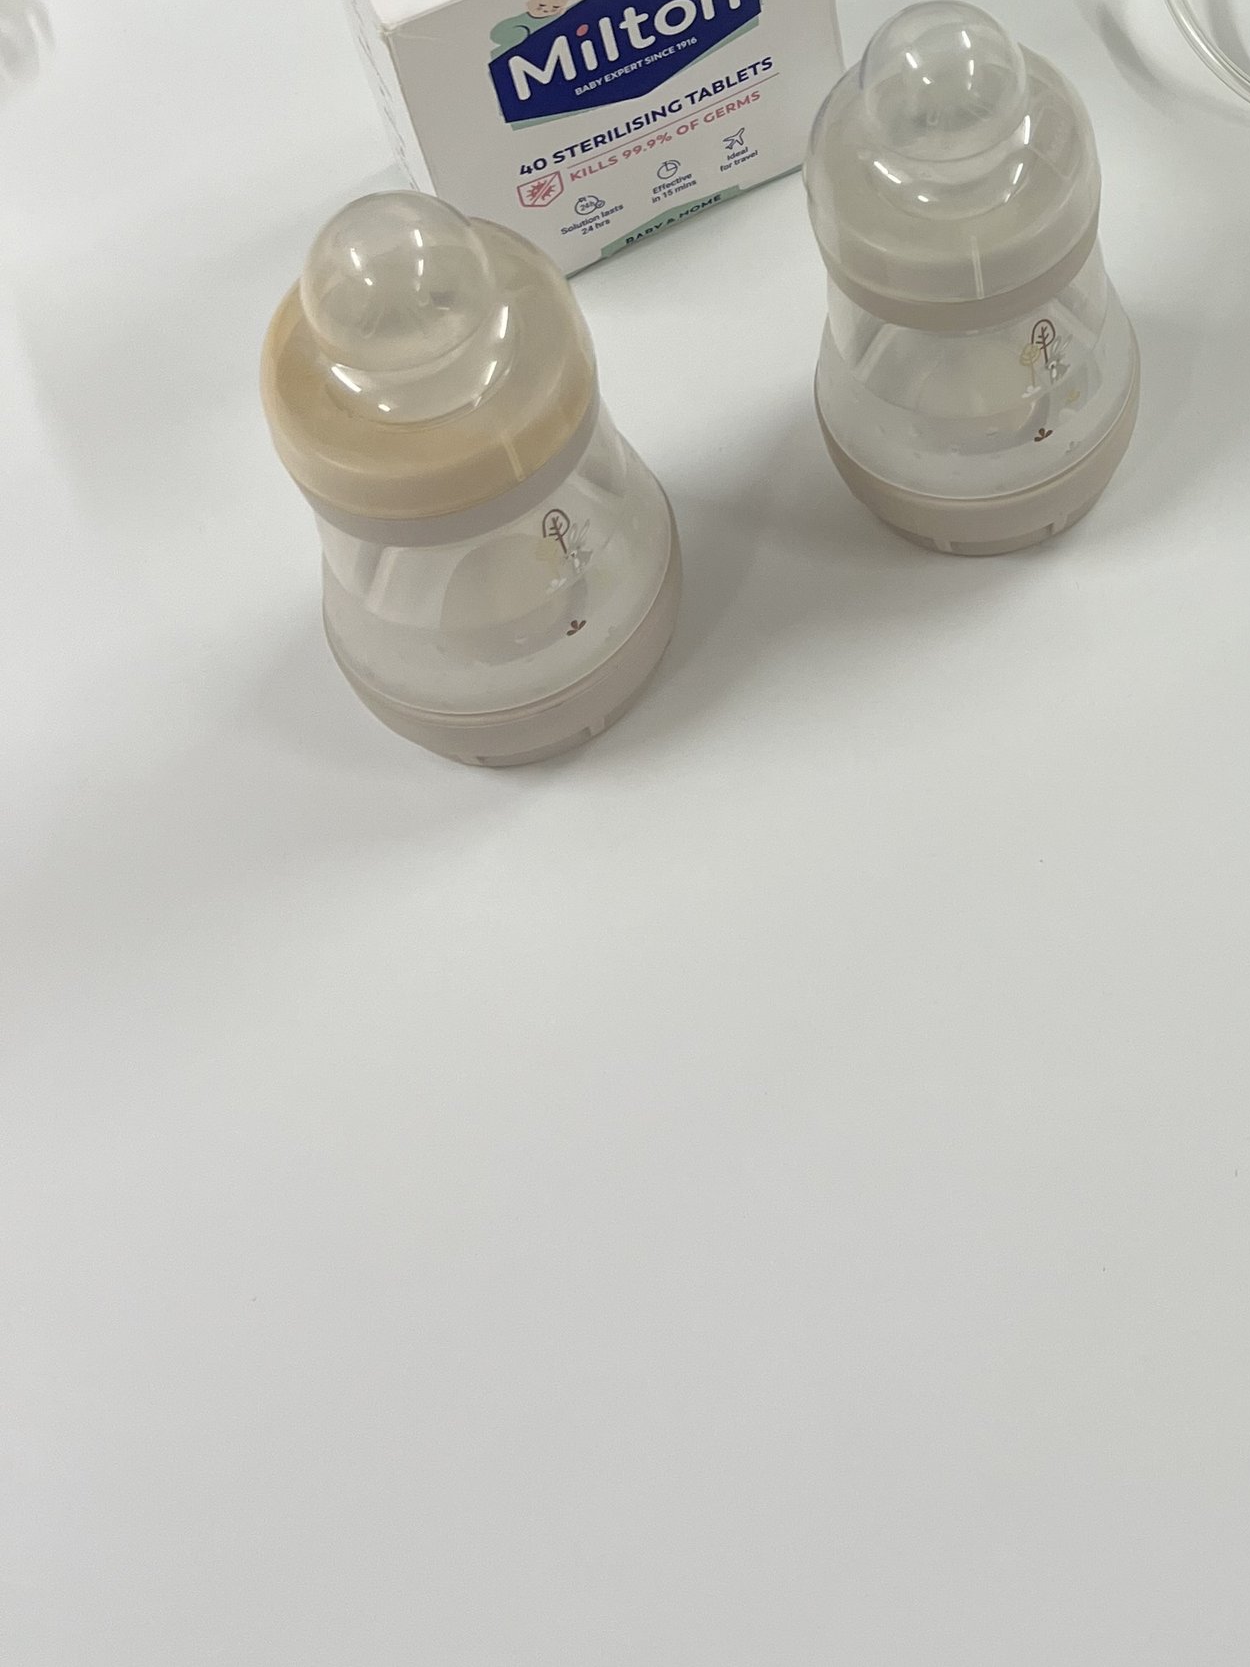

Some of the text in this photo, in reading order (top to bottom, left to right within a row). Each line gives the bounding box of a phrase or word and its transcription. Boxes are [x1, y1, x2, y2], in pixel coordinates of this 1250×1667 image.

[575, 36, 698, 96] BABY EXPERT SINCE 1916
[519, 56, 774, 177] 40 STERILISING TABLETS
[569, 90, 761, 182] KILLS 99.9% OF GERMS
[719, 149, 759, 172] for travel
[726, 146, 749, 162] Ideal
[652, 173, 693, 195] Effective
[652, 178, 698, 204] in 15 mins
[560, 203, 624, 235] Solution lasts
[581, 218, 611, 235] 24 hrs
